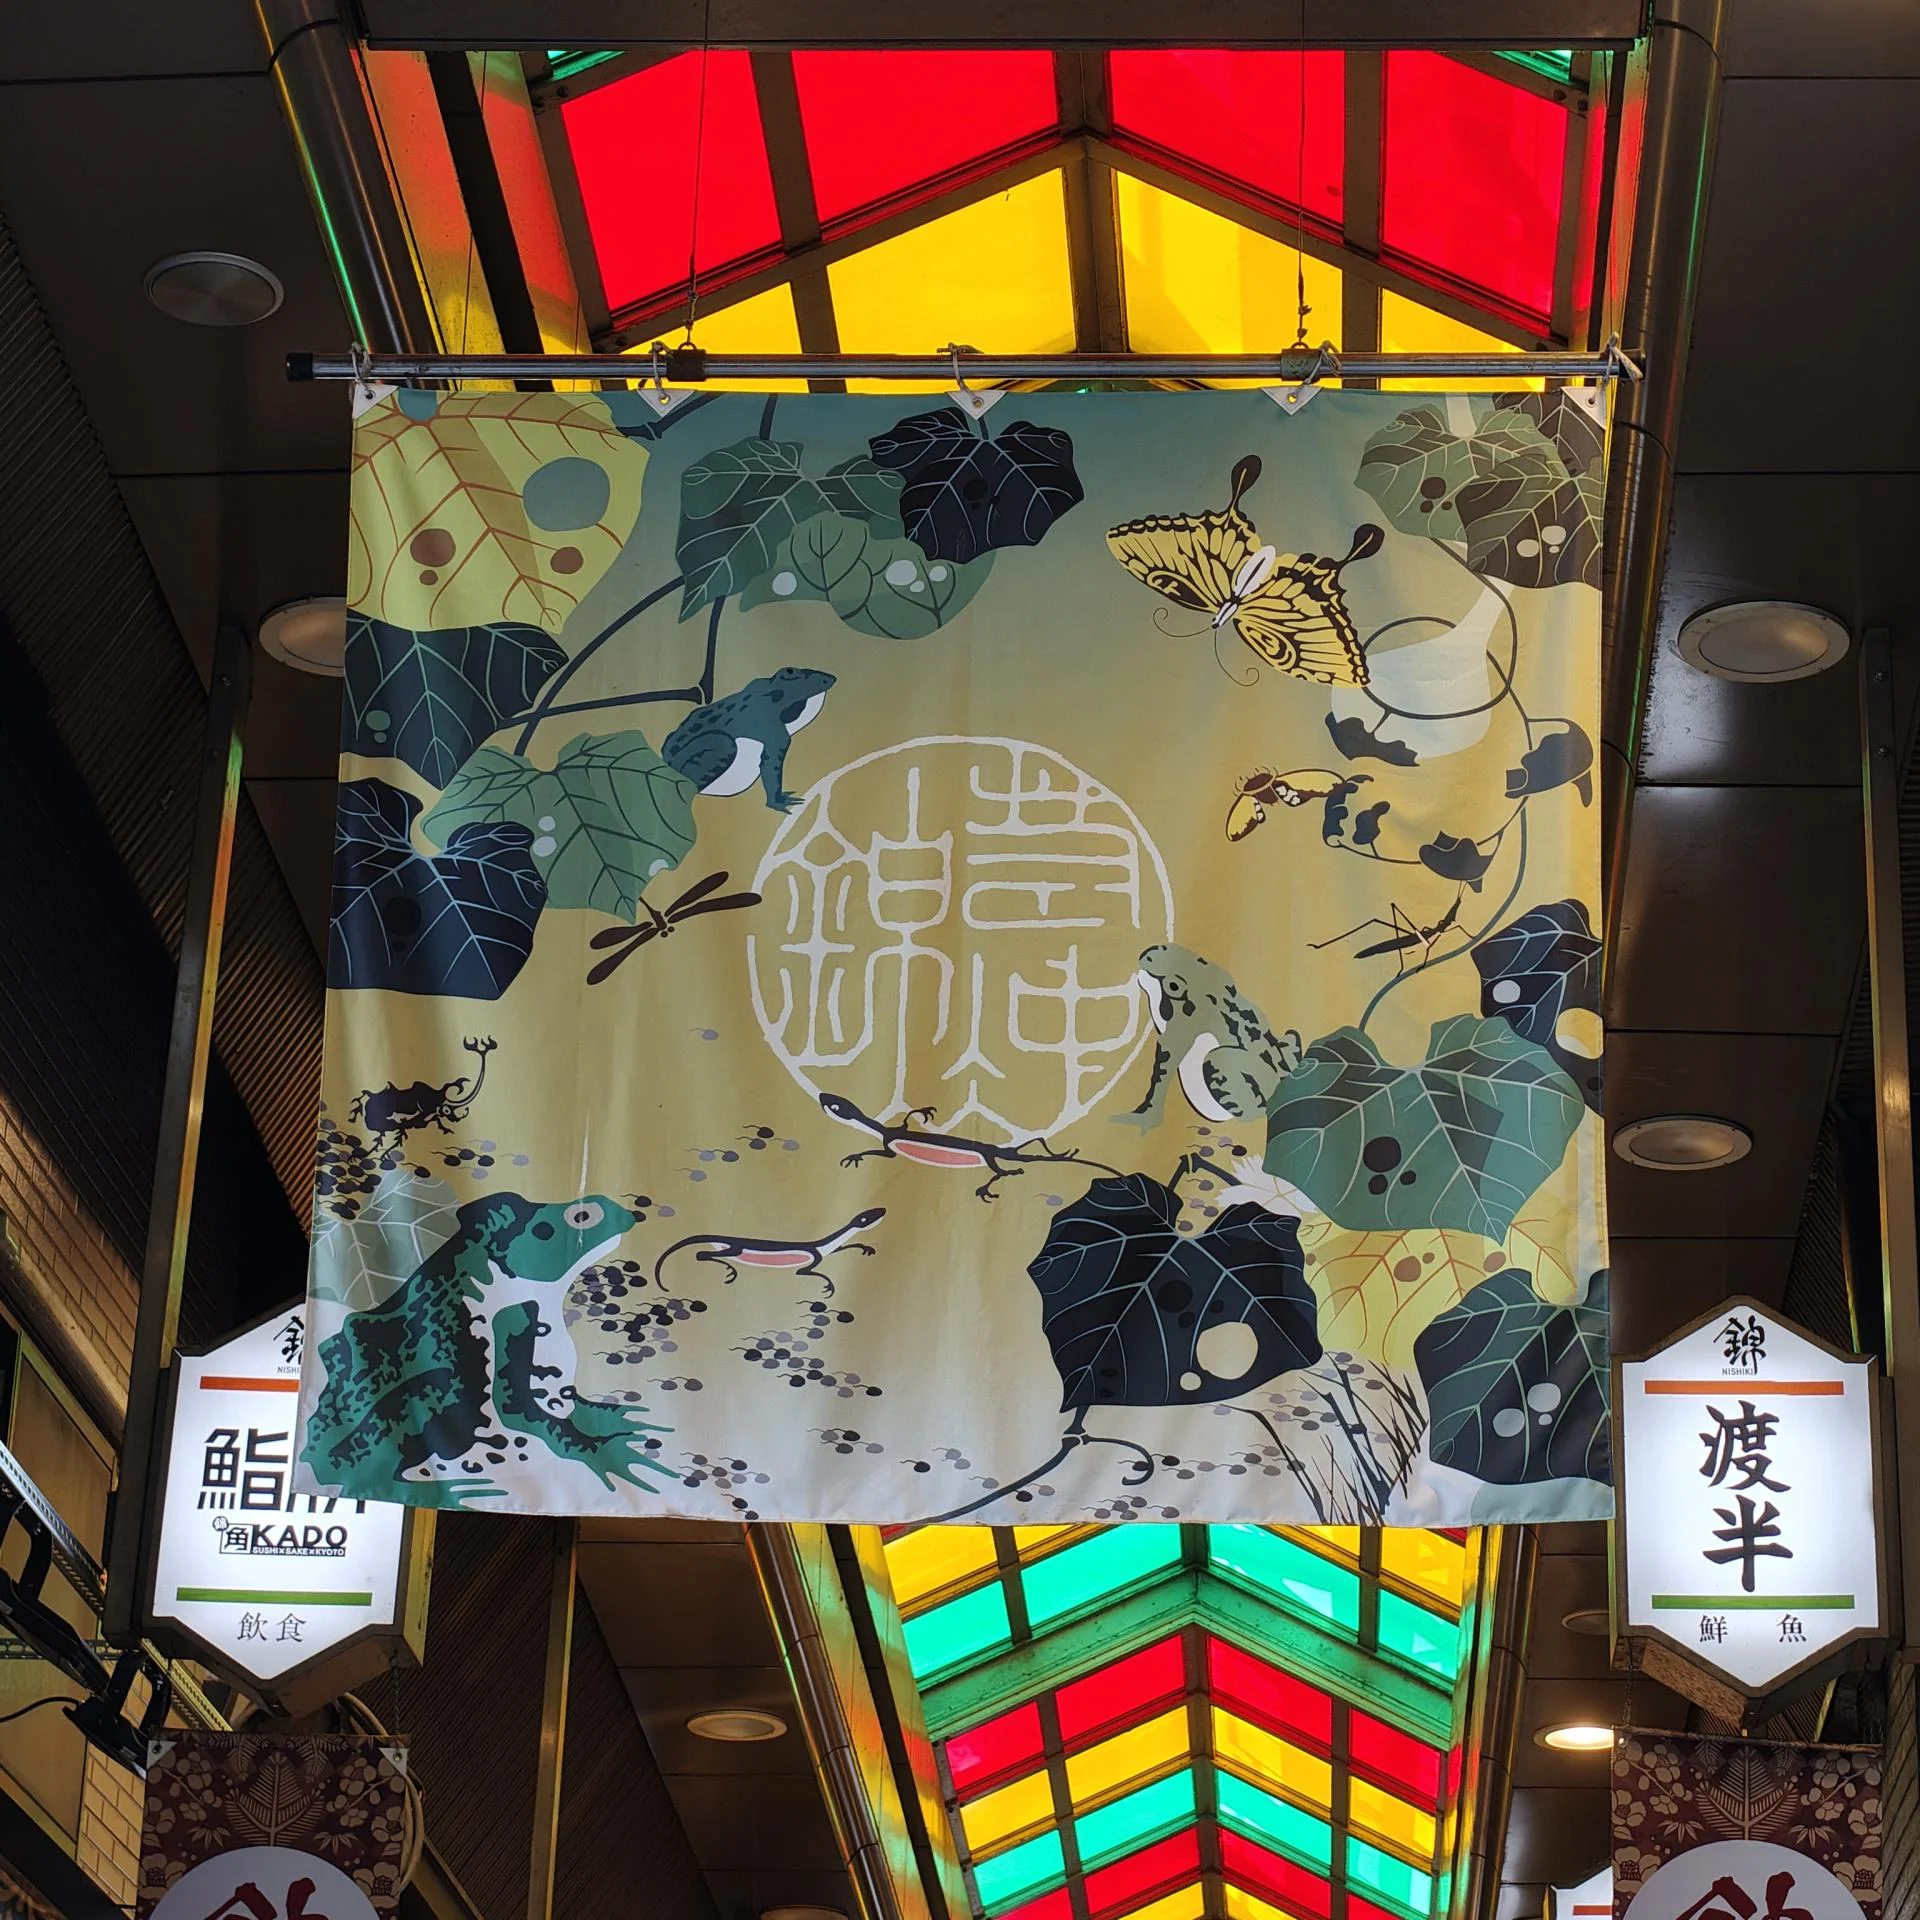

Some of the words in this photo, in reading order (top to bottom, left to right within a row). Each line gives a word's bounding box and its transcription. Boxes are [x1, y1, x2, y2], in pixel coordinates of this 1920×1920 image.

[1713, 1315, 1766, 1375] 錦
[277, 1366, 300, 1374] NISHI
[1722, 1367, 1754, 1376] NISHIKI
[1699, 1400, 1794, 1593] 渡半
[252, 1524, 348, 1547] KADO
[236, 1612, 306, 1643] 飲食
